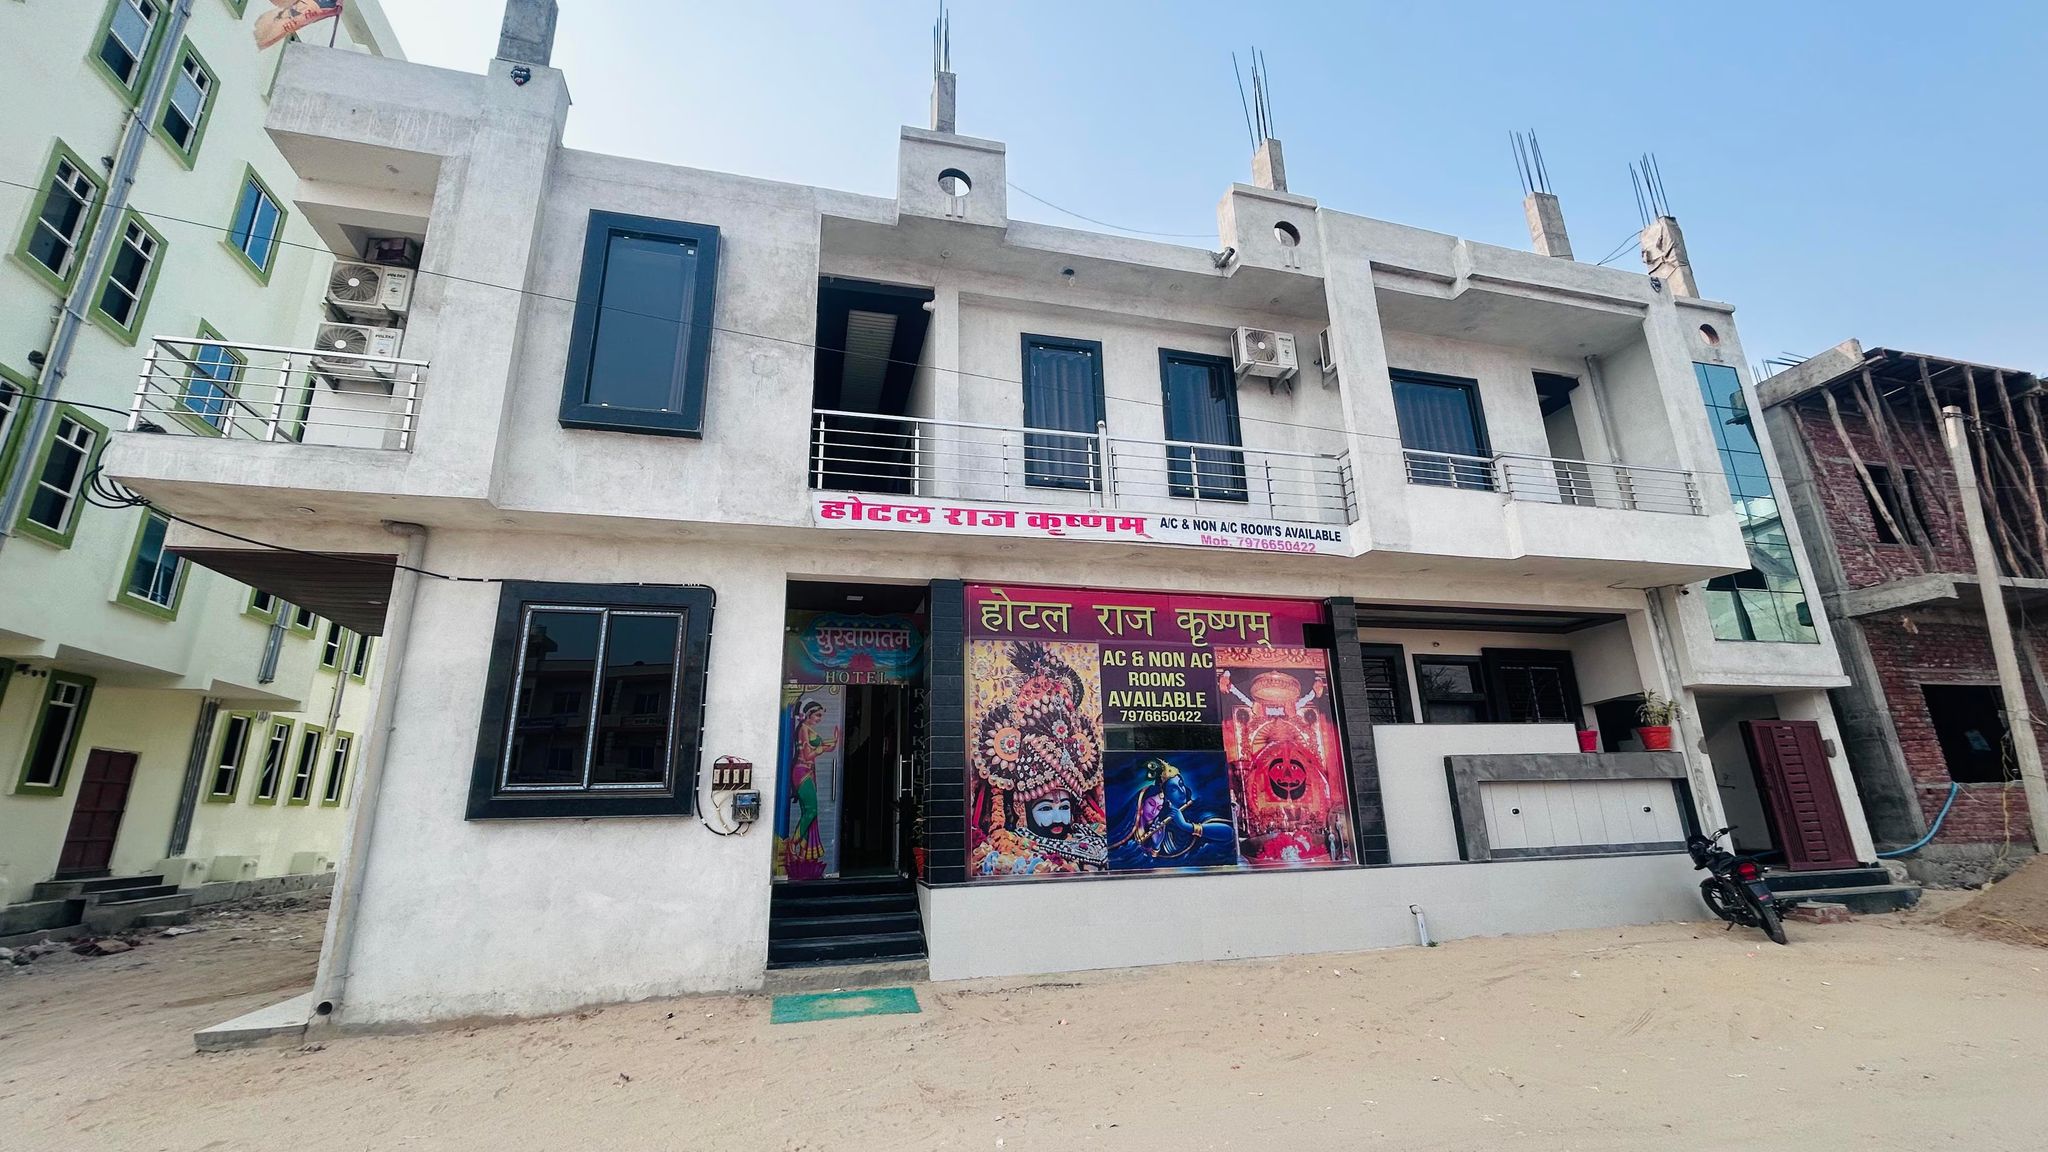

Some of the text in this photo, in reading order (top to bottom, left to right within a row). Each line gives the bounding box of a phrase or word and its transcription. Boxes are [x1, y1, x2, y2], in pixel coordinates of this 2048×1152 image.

[819, 496, 1152, 538] होटल राज कृष्णम्
[1160, 517, 1341, 542] A/C & NON A/C ROOM'S AVAILABLE
[1201, 534, 1317, 553] Mob. 7976650422
[979, 589, 1272, 649] होटल राज कृष्णम्
[1103, 650, 1213, 668] AC & NON AC
[826, 672, 890, 684] HOTEL
[1128, 671, 1186, 687] ROOMS
[1108, 690, 1207, 708] AVAILABLE
[1120, 710, 1202, 722] 7976650422
